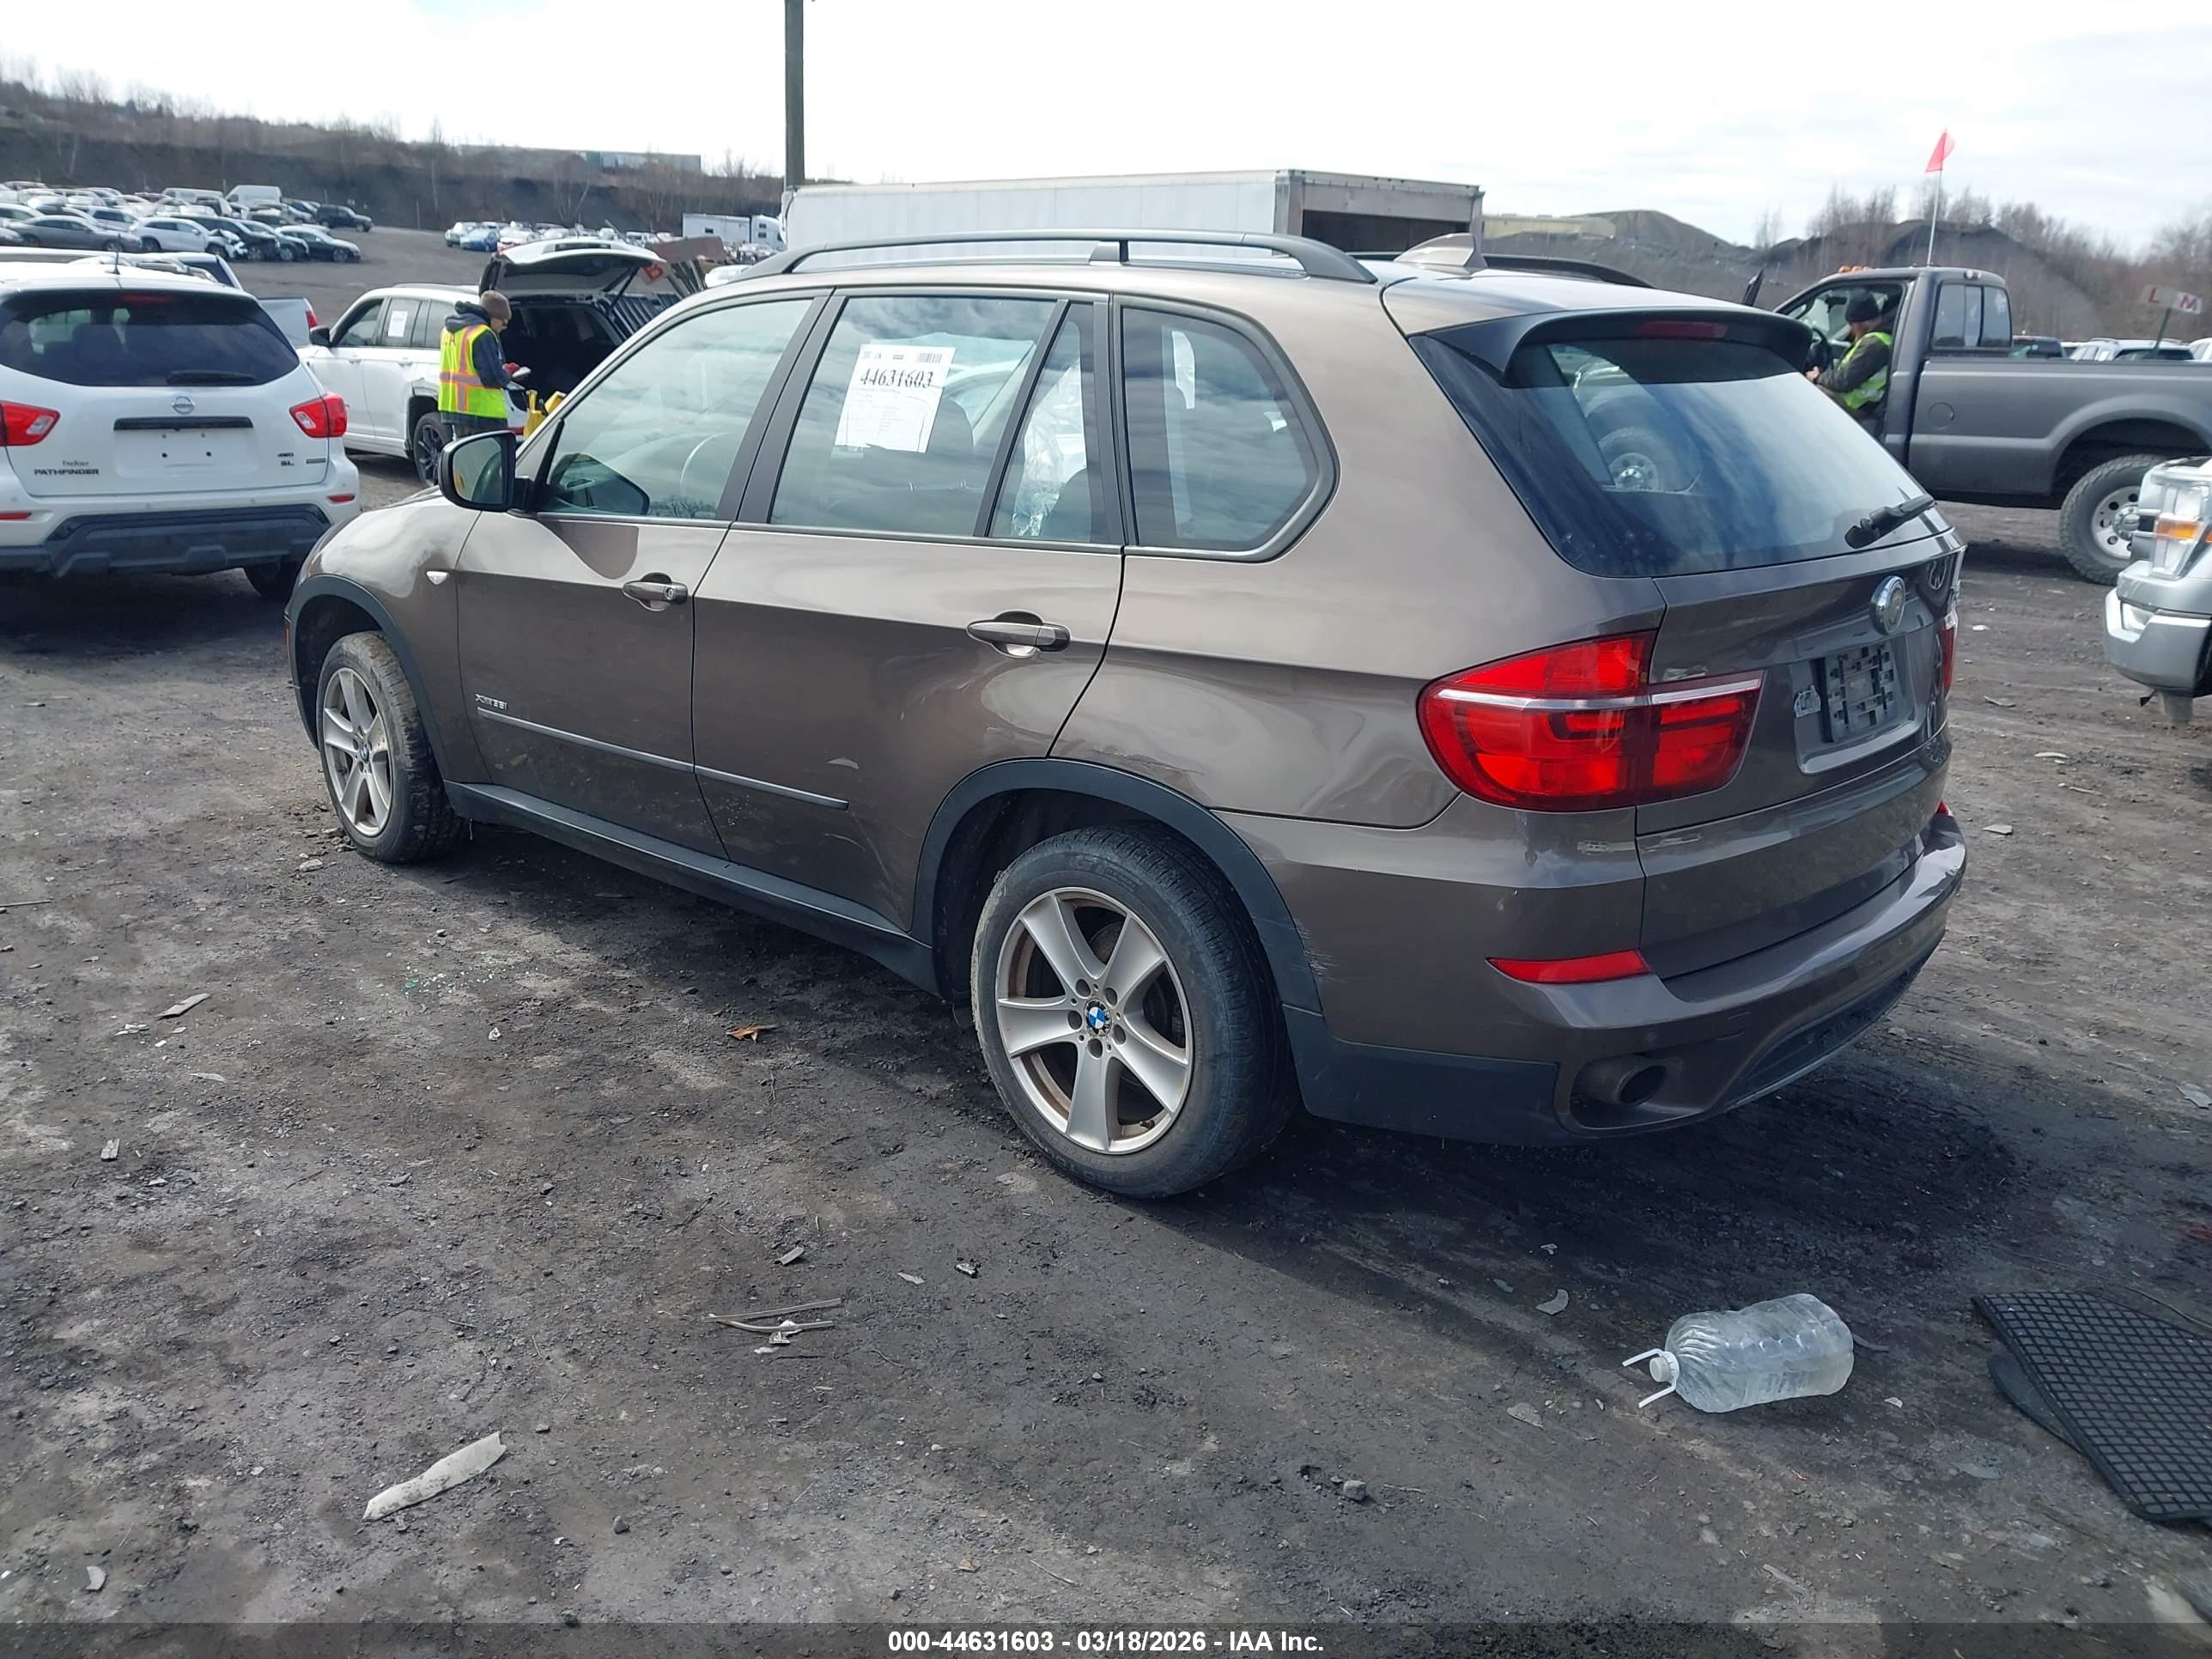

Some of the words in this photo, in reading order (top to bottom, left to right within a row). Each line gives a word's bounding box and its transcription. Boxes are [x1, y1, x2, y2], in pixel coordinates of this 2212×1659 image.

[2148, 289, 2160, 302] L
[2180, 295, 2198, 310] M
[860, 368, 934, 388] 44631603
